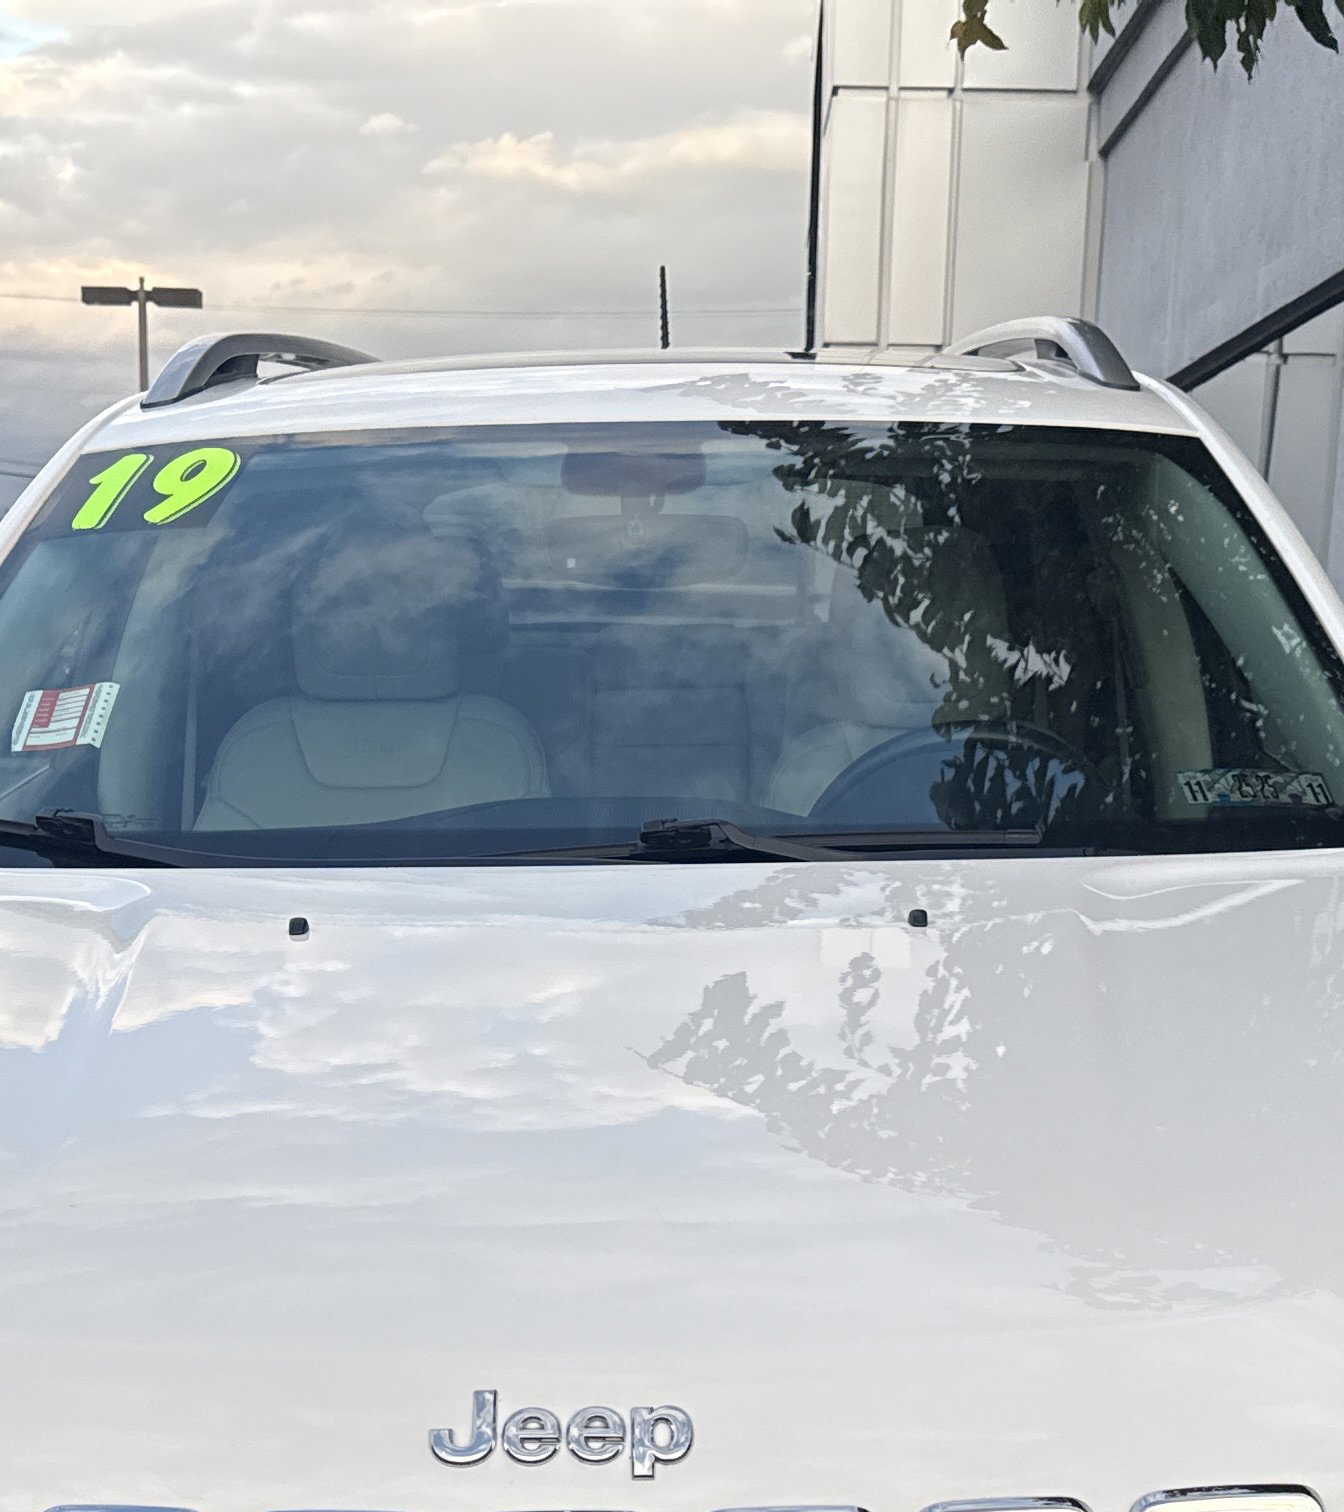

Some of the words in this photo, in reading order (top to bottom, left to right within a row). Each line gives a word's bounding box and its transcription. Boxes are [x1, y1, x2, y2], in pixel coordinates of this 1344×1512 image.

[72, 447, 241, 531] 19
[1184, 780, 1209, 802] 11
[1306, 782, 1332, 803] 11
[428, 1388, 695, 1481] Jeep
